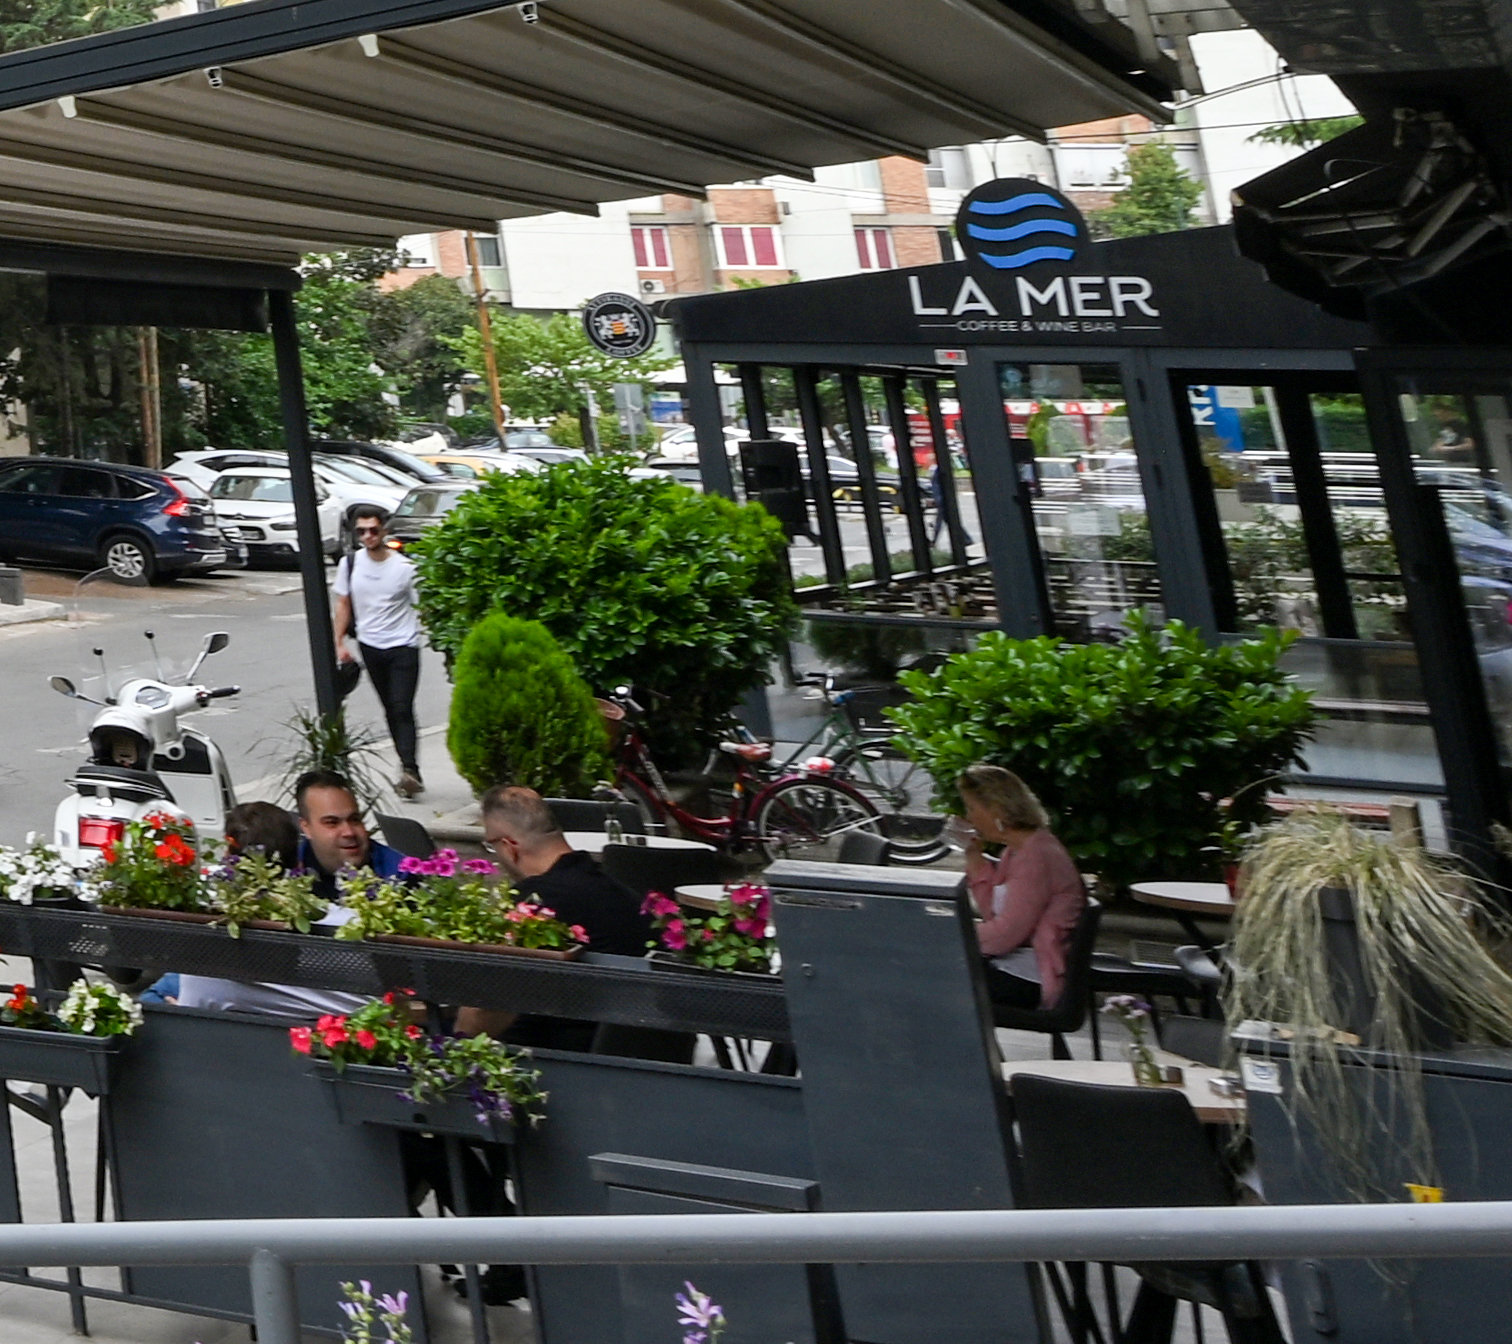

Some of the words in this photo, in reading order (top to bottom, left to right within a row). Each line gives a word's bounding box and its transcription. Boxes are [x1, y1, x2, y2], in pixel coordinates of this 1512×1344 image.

[908, 275, 999, 316] LA
[1015, 275, 1161, 317] MER
[956, 320, 1018, 331] COFFEE
[1021, 320, 1033, 331] &
[1035, 321, 1080, 332] WINE
[1082, 322, 1117, 333] BAR
